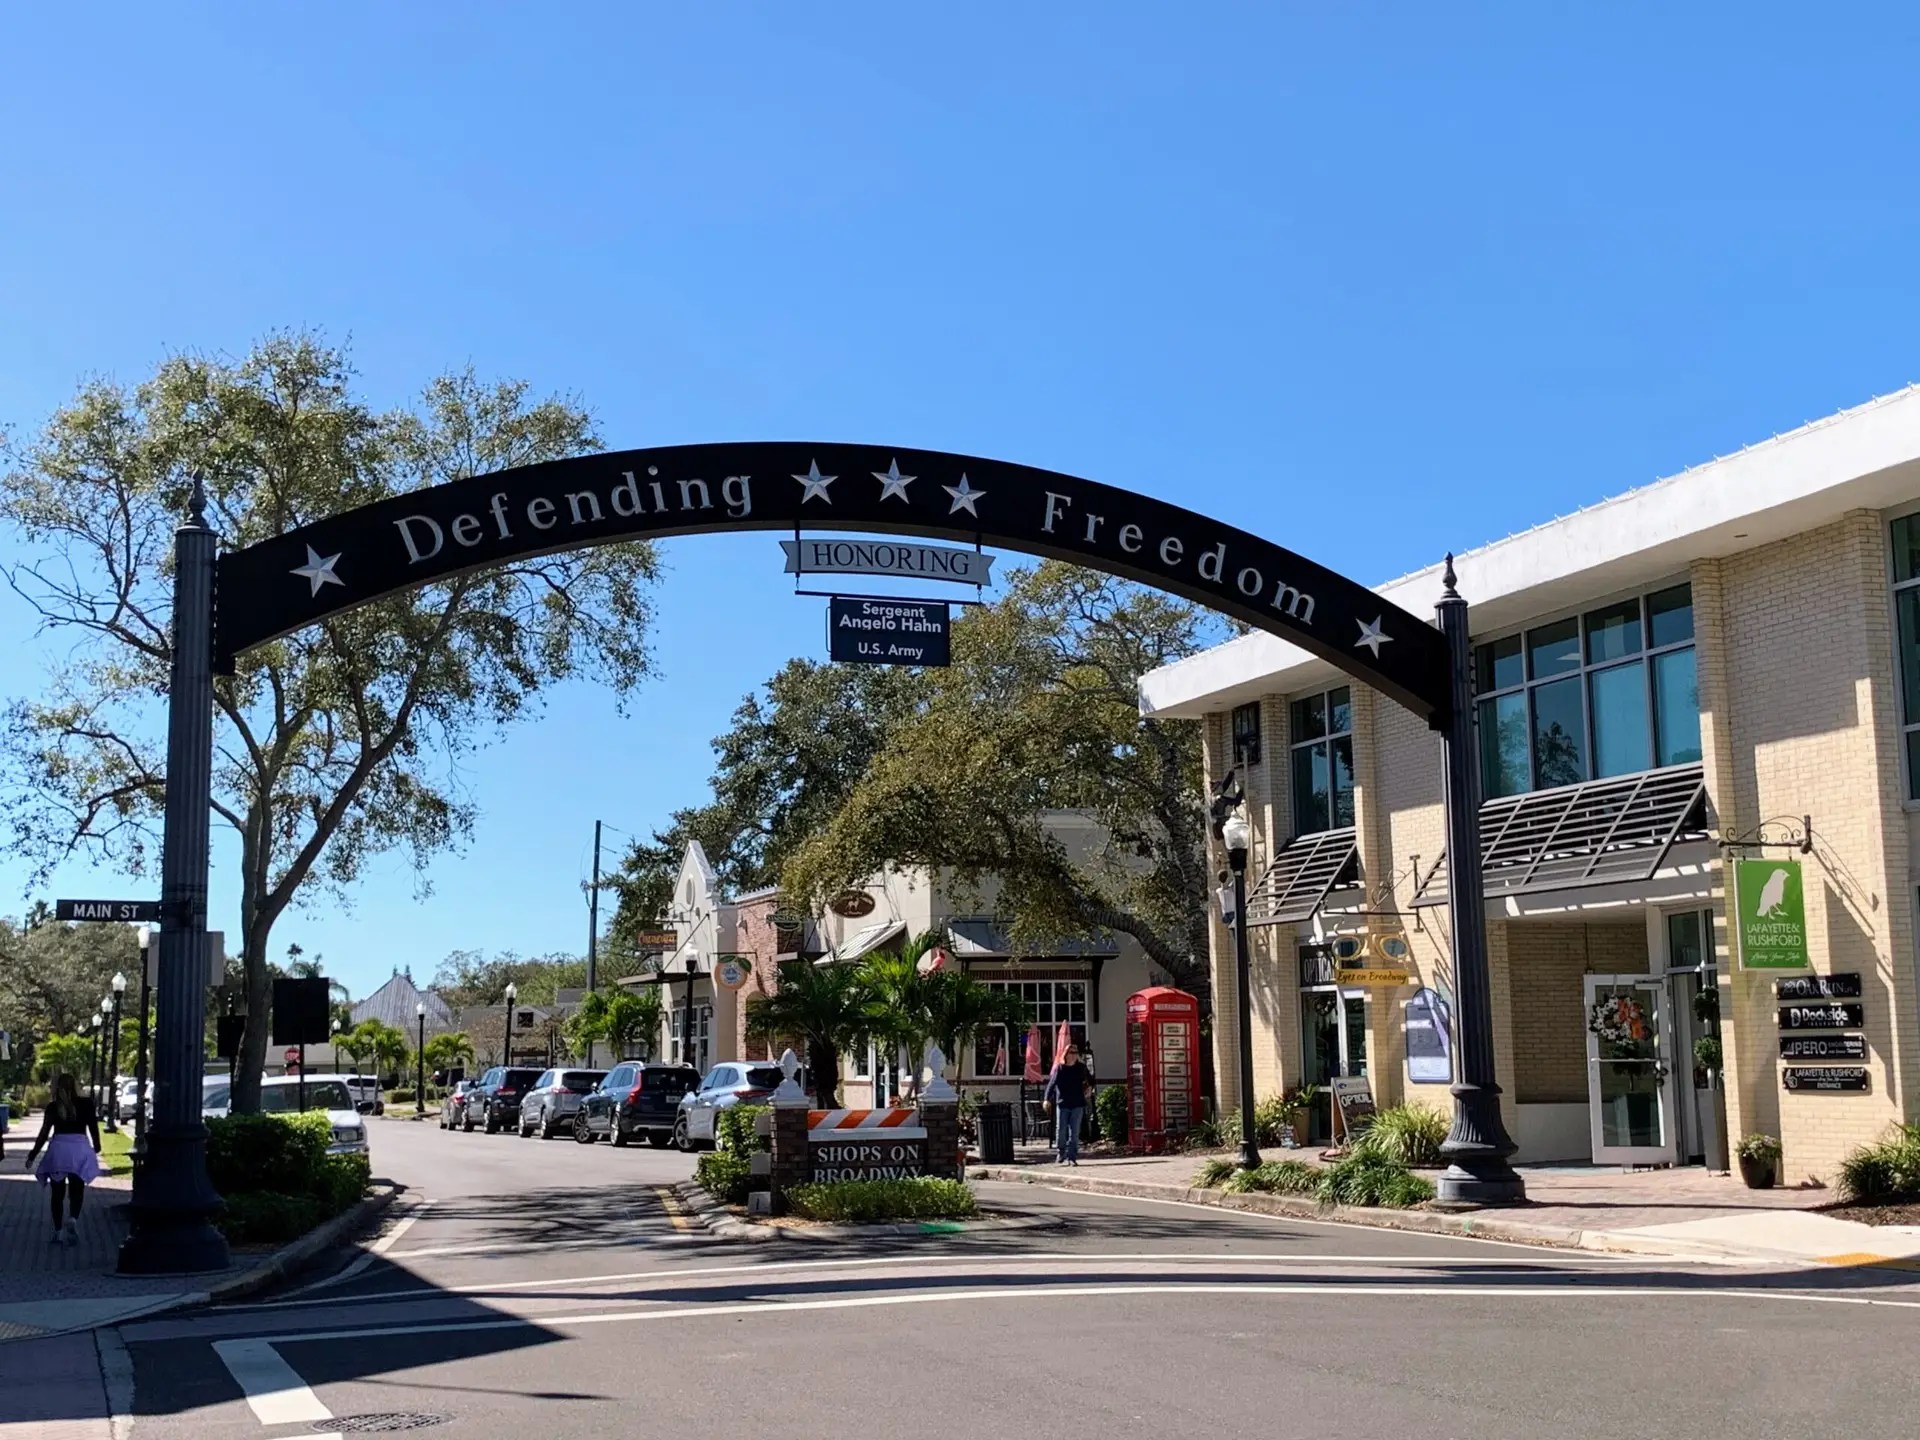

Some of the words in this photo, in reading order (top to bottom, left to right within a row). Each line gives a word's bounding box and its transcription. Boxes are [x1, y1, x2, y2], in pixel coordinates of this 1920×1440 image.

[393, 465, 752, 564] Defending
[1041, 490, 1317, 626] Freedom
[812, 543, 969, 575] HONORING
[862, 602, 925, 619] Sergeant
[839, 614, 896, 631] Angelo
[902, 618, 942, 633] Hahn
[858, 642, 884, 655] U.S.
[888, 643, 924, 660] Army
[73, 903, 112, 918] MAIN
[120, 904, 139, 919] ST
[1747, 934, 1802, 946] RUSHFORD
[817, 1145, 882, 1162] SHOPS
[890, 1144, 919, 1161] ON
[814, 1166, 922, 1184] BROADWAY
